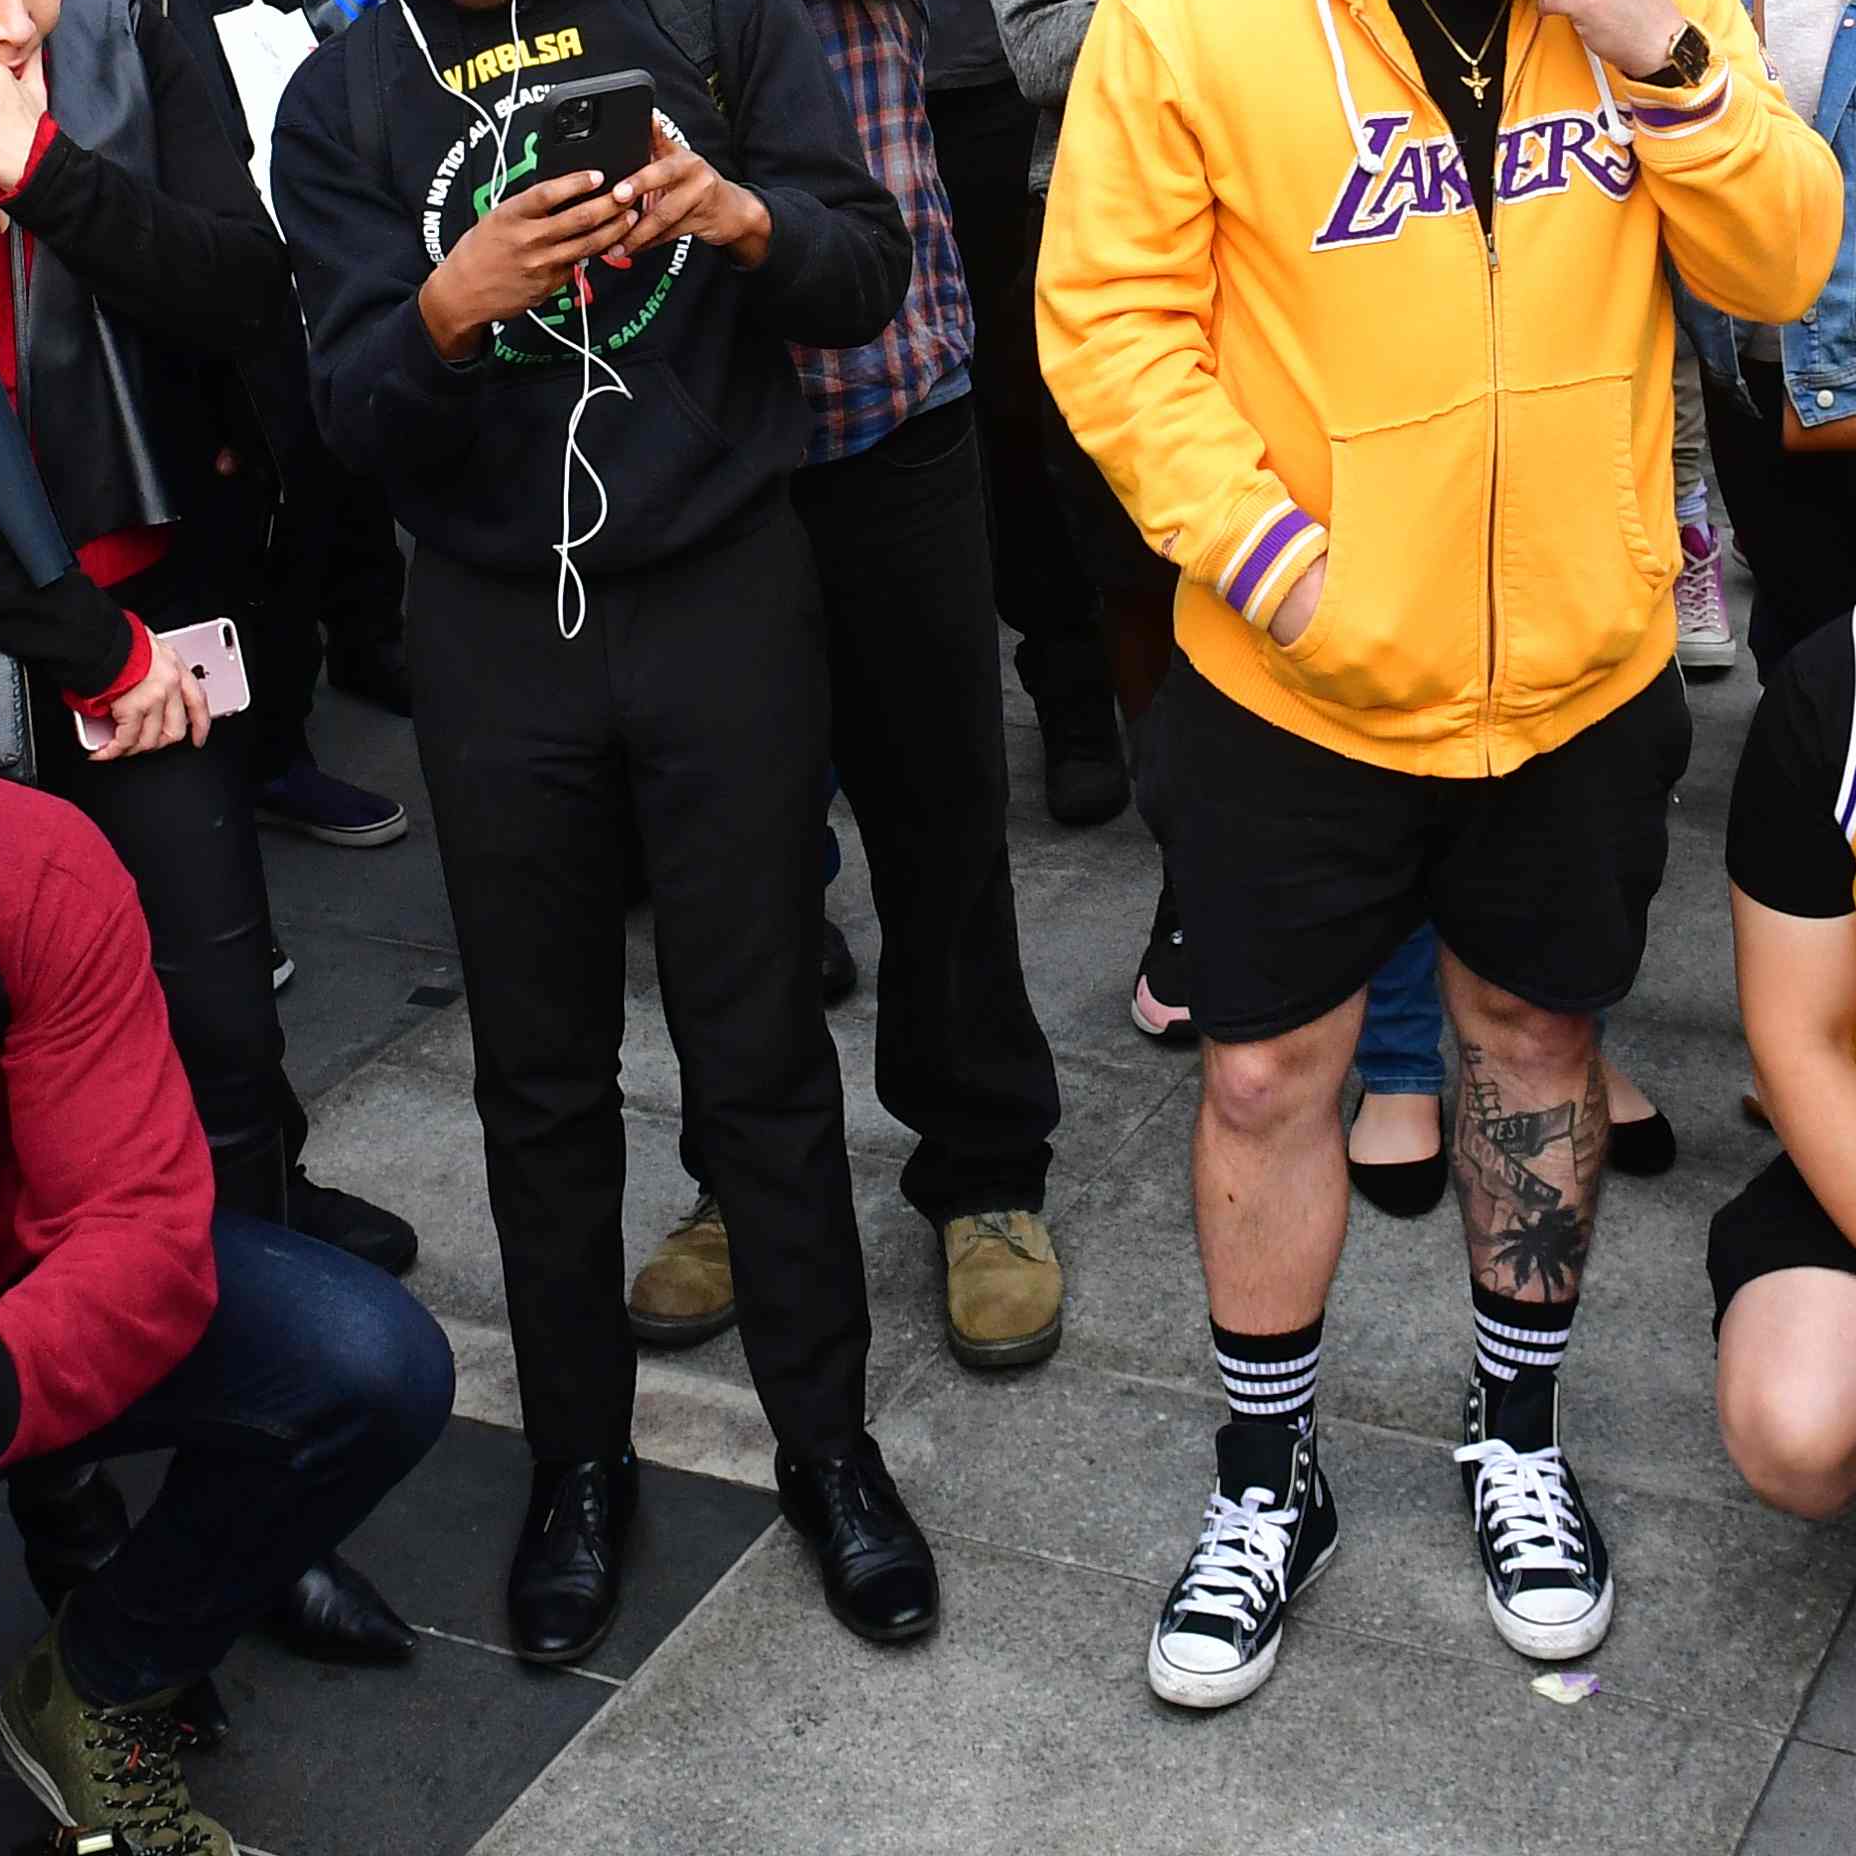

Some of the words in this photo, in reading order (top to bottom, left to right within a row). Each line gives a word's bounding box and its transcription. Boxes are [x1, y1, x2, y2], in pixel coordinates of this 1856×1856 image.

[427, 119, 493, 207] NATIOAL
[1308, 110, 1639, 254] LAKERS
[423, 211, 444, 264] EGION
[1485, 1117, 1531, 1141] WEST
[1470, 1134, 1530, 1197] COAST
